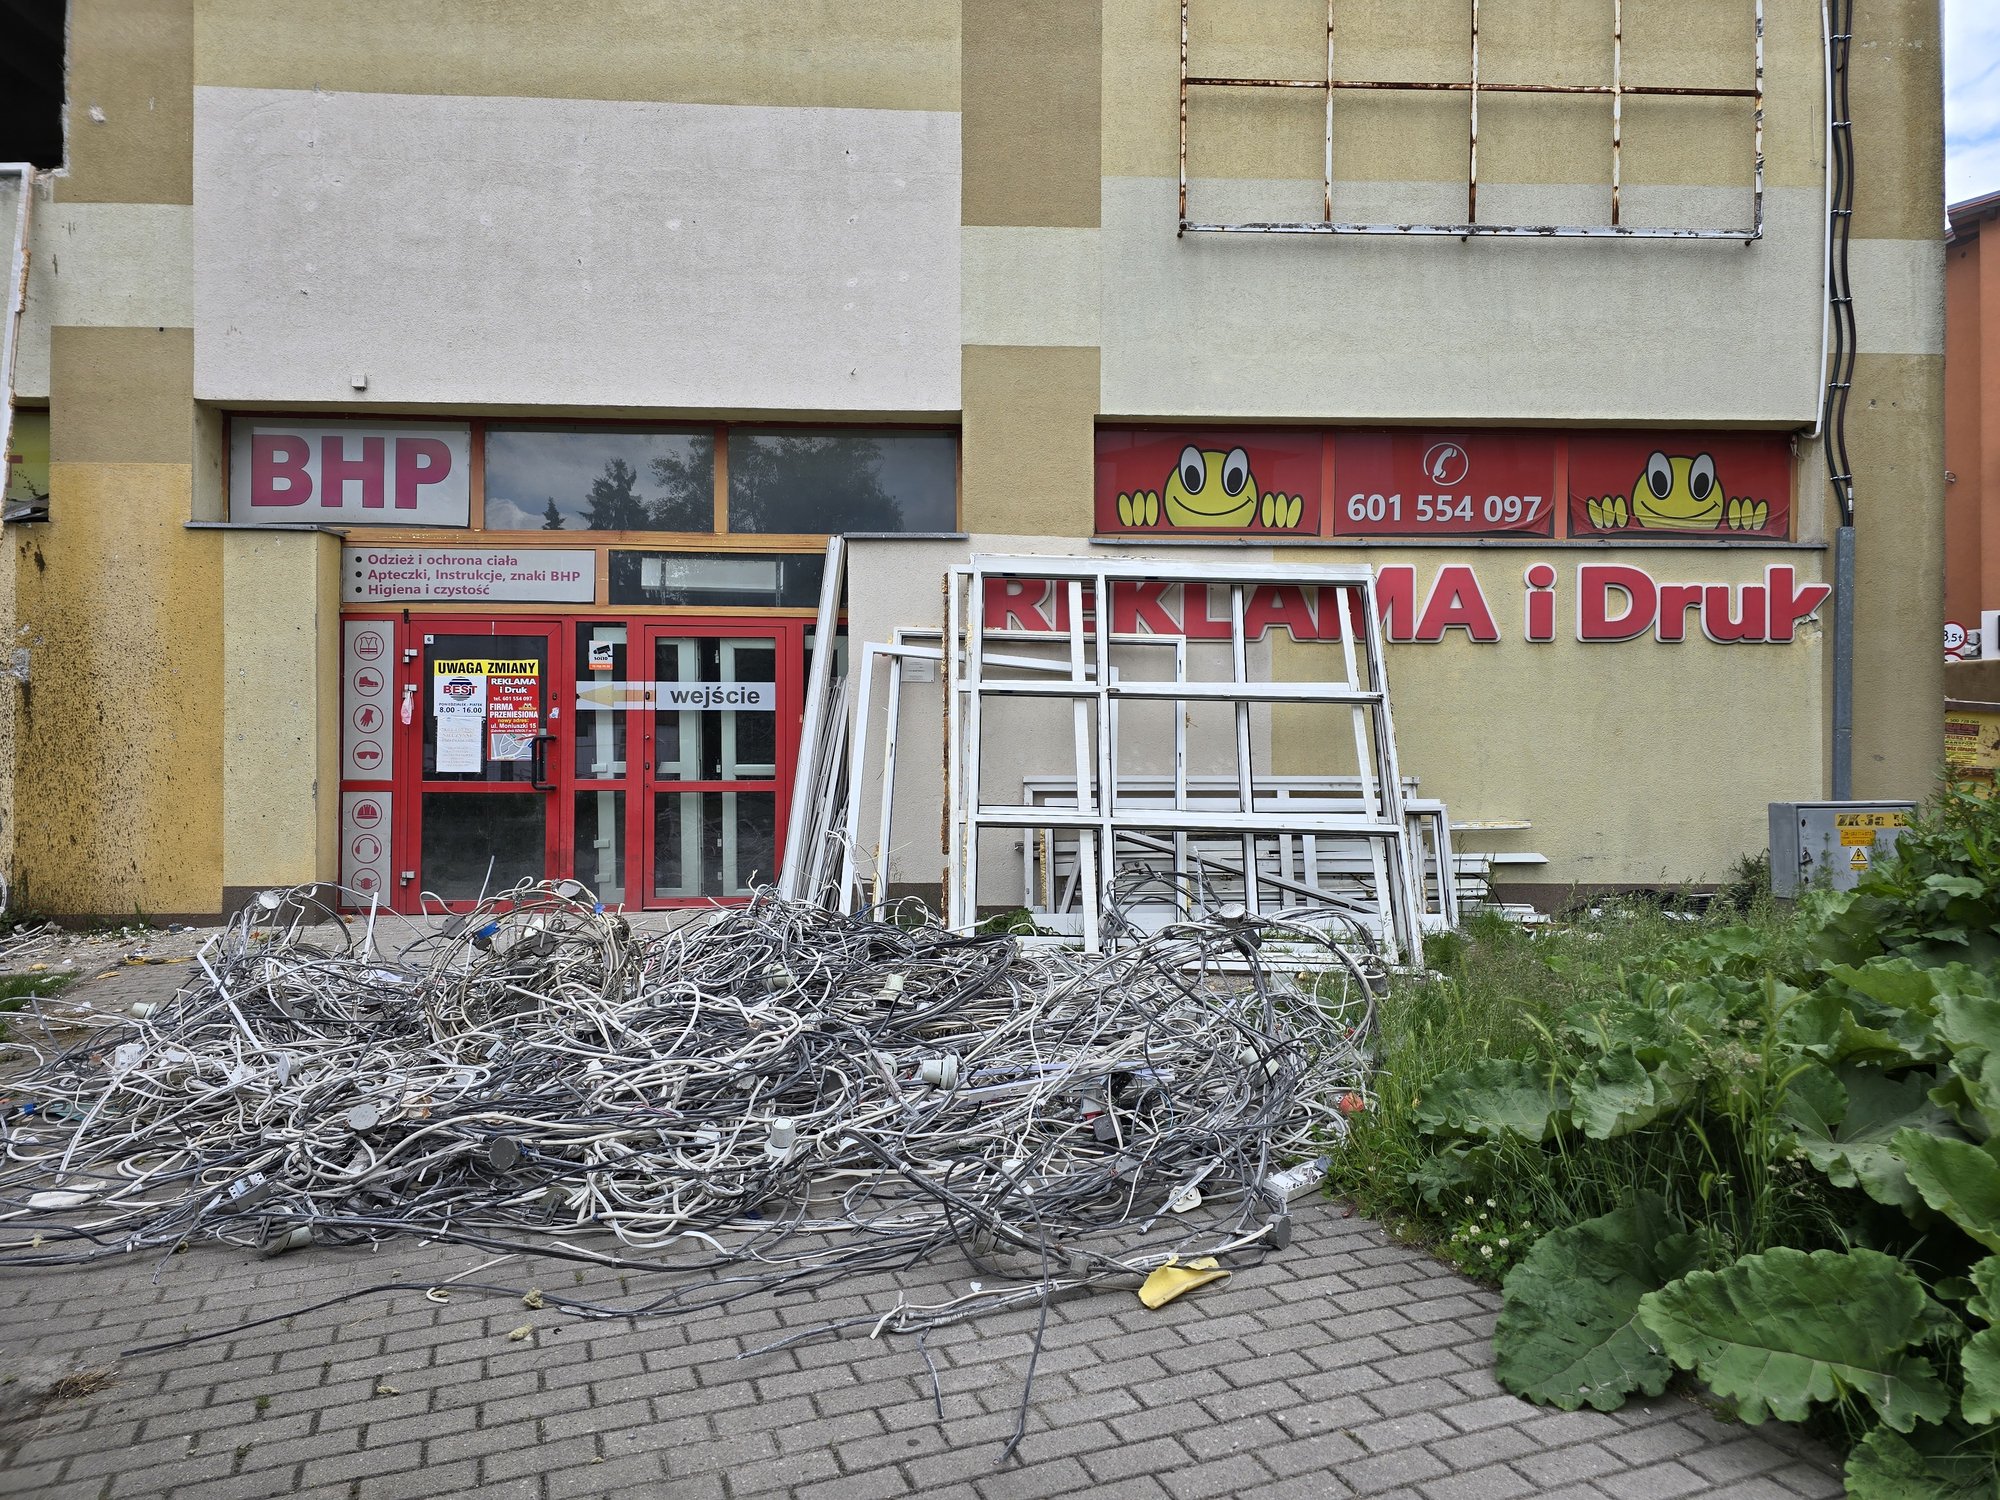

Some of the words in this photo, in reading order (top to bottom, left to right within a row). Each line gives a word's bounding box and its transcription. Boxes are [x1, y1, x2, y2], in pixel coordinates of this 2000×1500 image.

[251, 434, 452, 509] BHP
[1347, 494, 1401, 521] 601
[1416, 495, 1474, 522] 554
[1484, 496, 1542, 522] 097
[368, 554, 414, 565] Odzież
[418, 554, 422, 565] i
[426, 554, 482, 566] ochrona
[487, 555, 518, 566] ciała
[368, 569, 431, 583] Apteczki,
[436, 569, 506, 583] Instrukcje,
[510, 570, 546, 581] znaki
[551, 571, 581, 582] BHP
[368, 584, 421, 597] Higiena
[425, 584, 429, 594] i
[433, 584, 490, 597] czystość
[983, 565, 1500, 643] REKLAMA
[1524, 563, 1558, 642] i
[1577, 563, 1832, 644] Druk
[438, 662, 483, 674] UWAGA
[487, 662, 536, 674] ZMIANY
[443, 685, 478, 694] BEST
[670, 686, 760, 709] wejście
